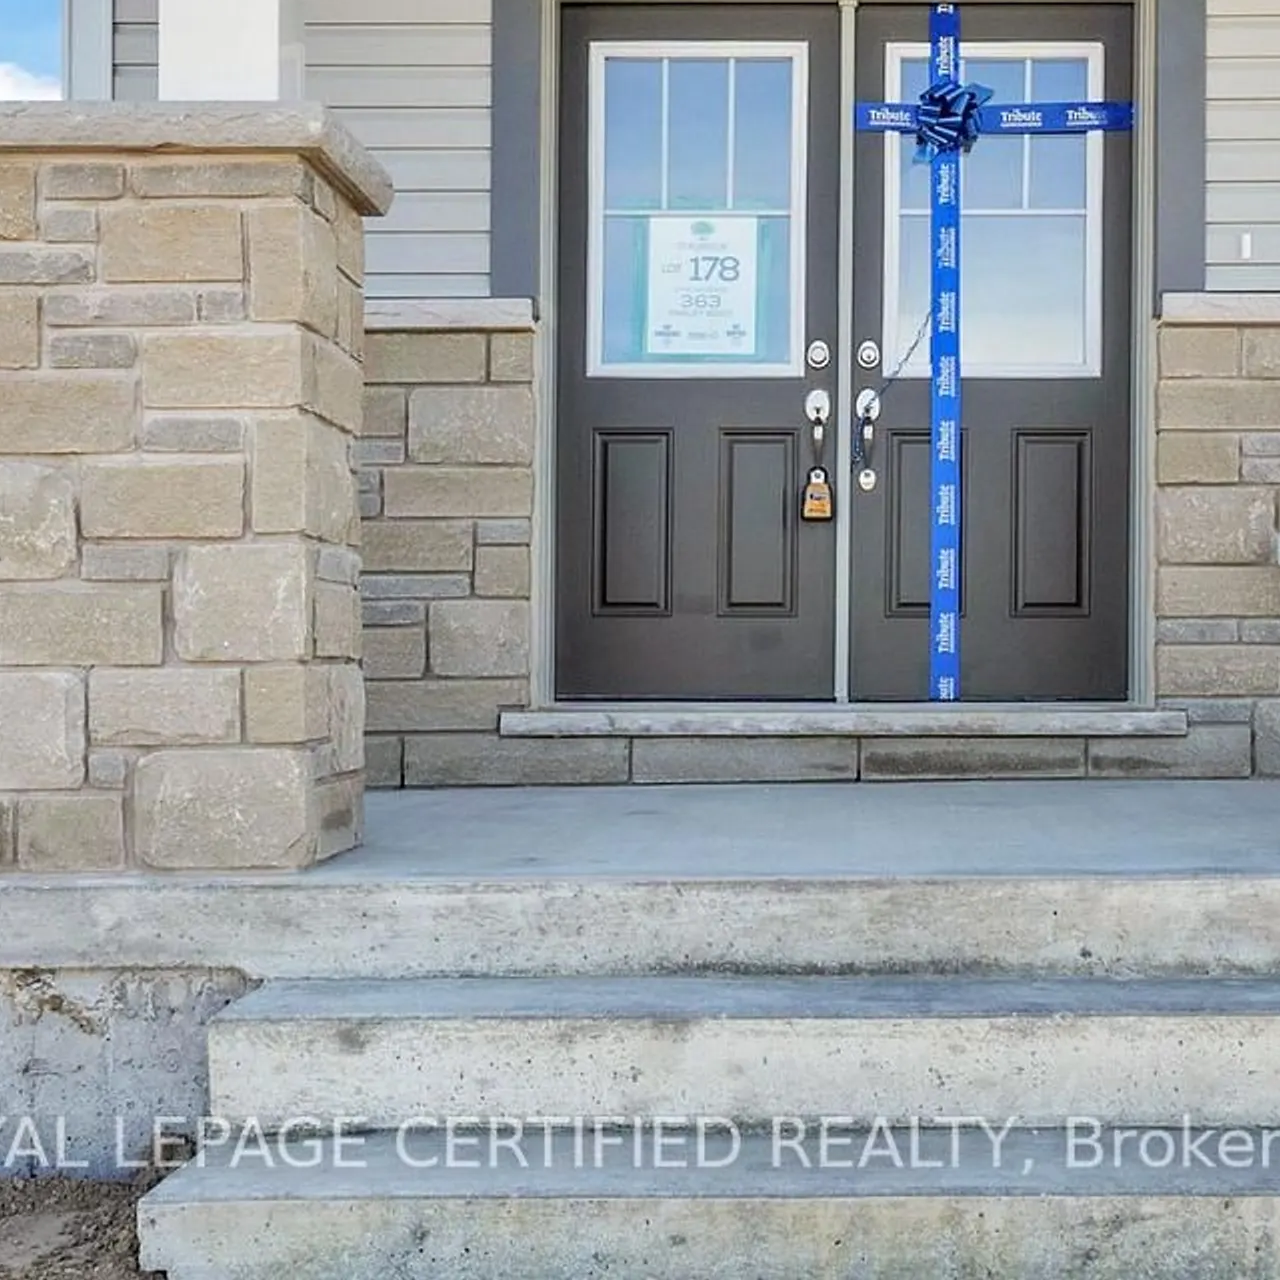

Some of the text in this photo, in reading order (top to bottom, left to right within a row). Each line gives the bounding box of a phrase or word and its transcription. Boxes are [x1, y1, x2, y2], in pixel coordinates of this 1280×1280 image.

[870, 107, 911, 121] Tribute
[1000, 107, 1042, 122] Tribute
[689, 256, 740, 281] 178
[680, 294, 721, 308] 363
